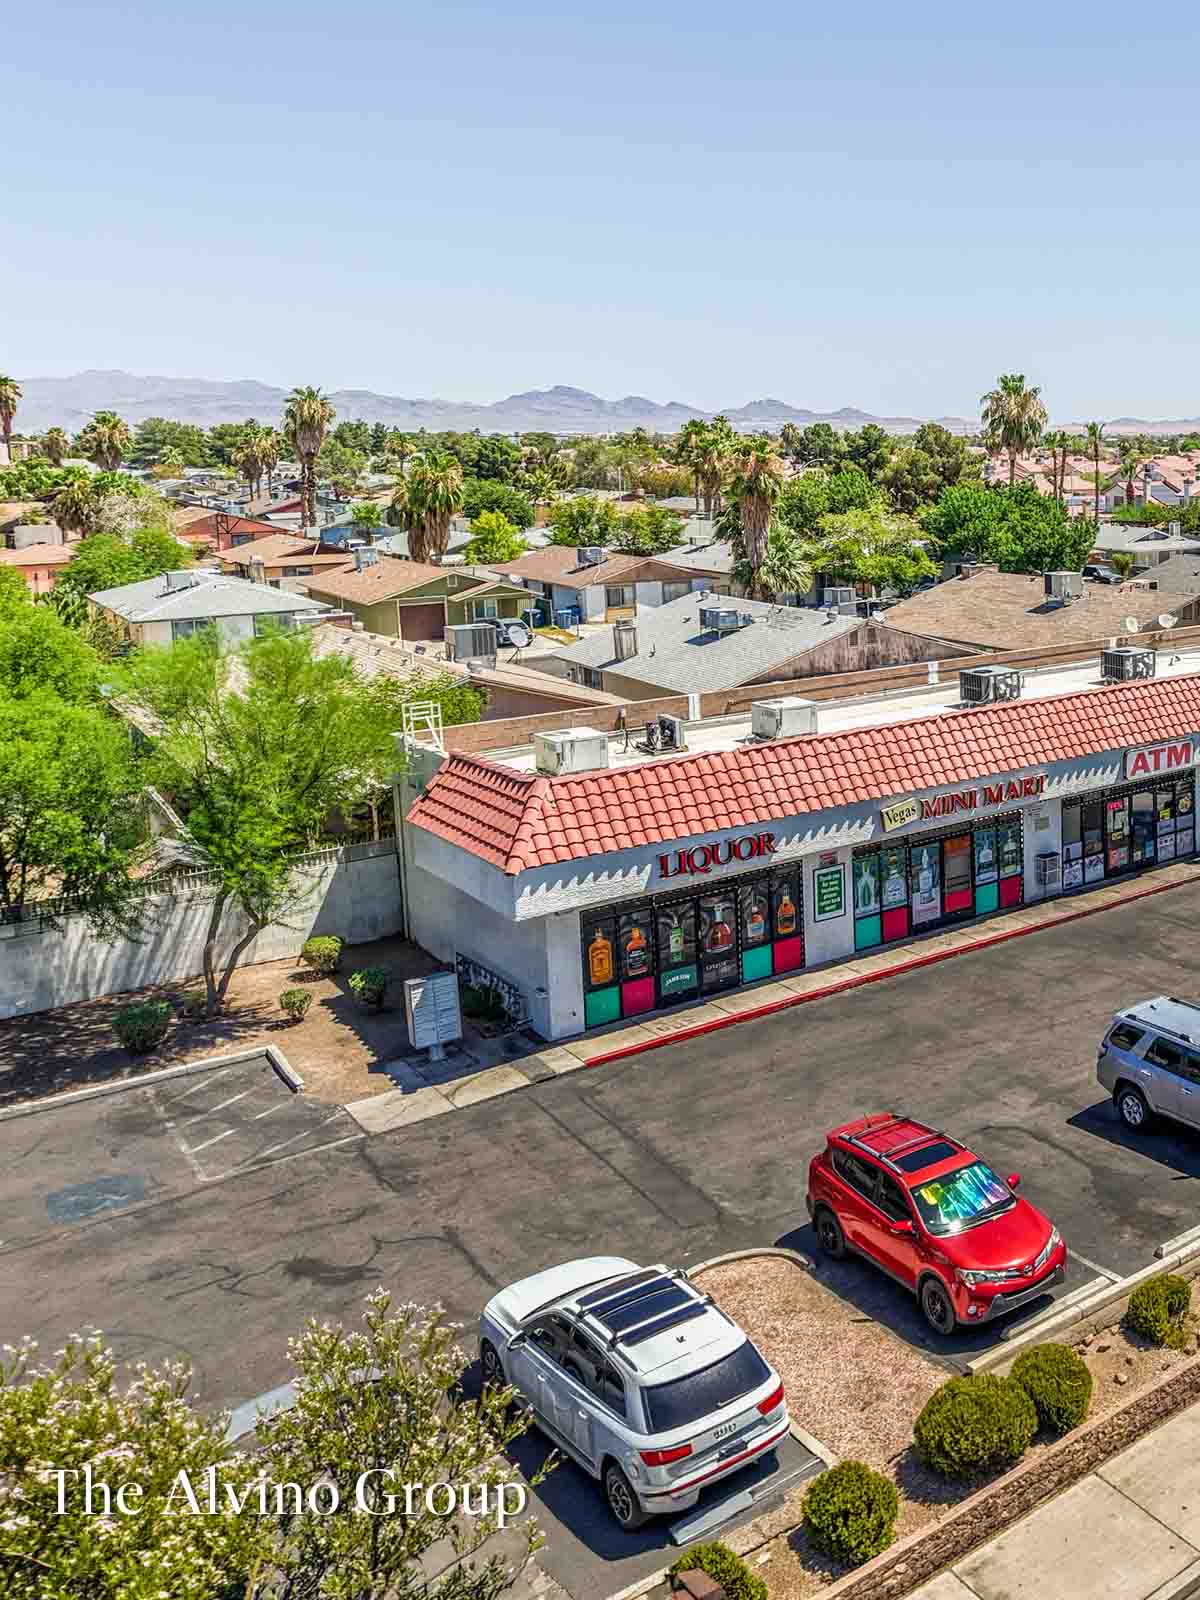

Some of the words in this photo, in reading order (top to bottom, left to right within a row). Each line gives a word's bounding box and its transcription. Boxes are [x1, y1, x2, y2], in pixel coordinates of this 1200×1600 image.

[1130, 743, 1191, 776] ATM
[885, 804, 917, 824] Vegas
[919, 788, 979, 820] MINI
[983, 773, 1049, 806] MART
[657, 832, 777, 878] LIQUOR
